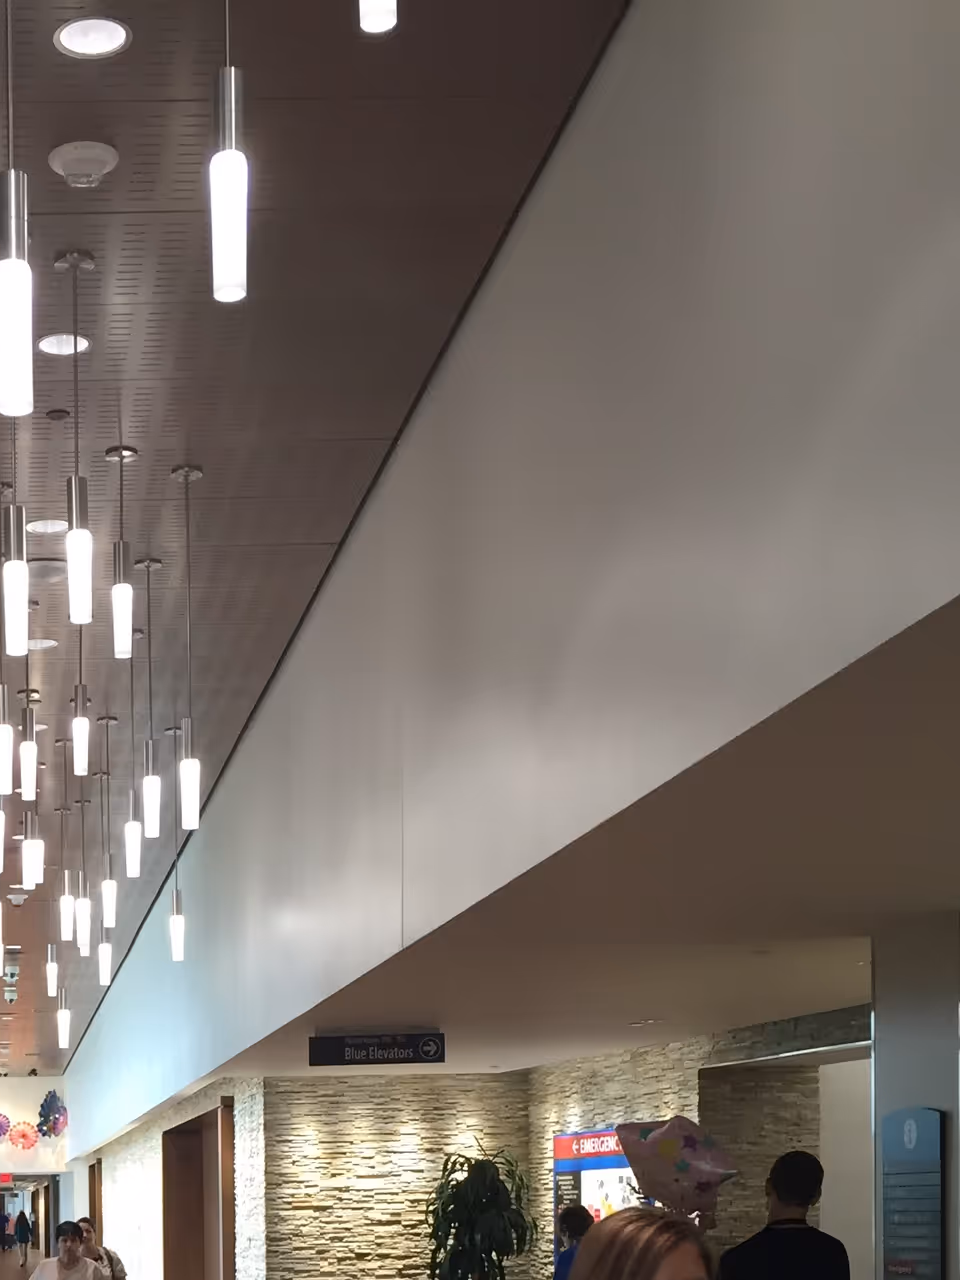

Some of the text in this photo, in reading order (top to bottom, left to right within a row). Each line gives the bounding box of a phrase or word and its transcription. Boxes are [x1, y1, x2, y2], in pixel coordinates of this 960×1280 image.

[344, 1045, 414, 1060] Blue Elevators
[580, 1135, 622, 1154] EMERGENC
